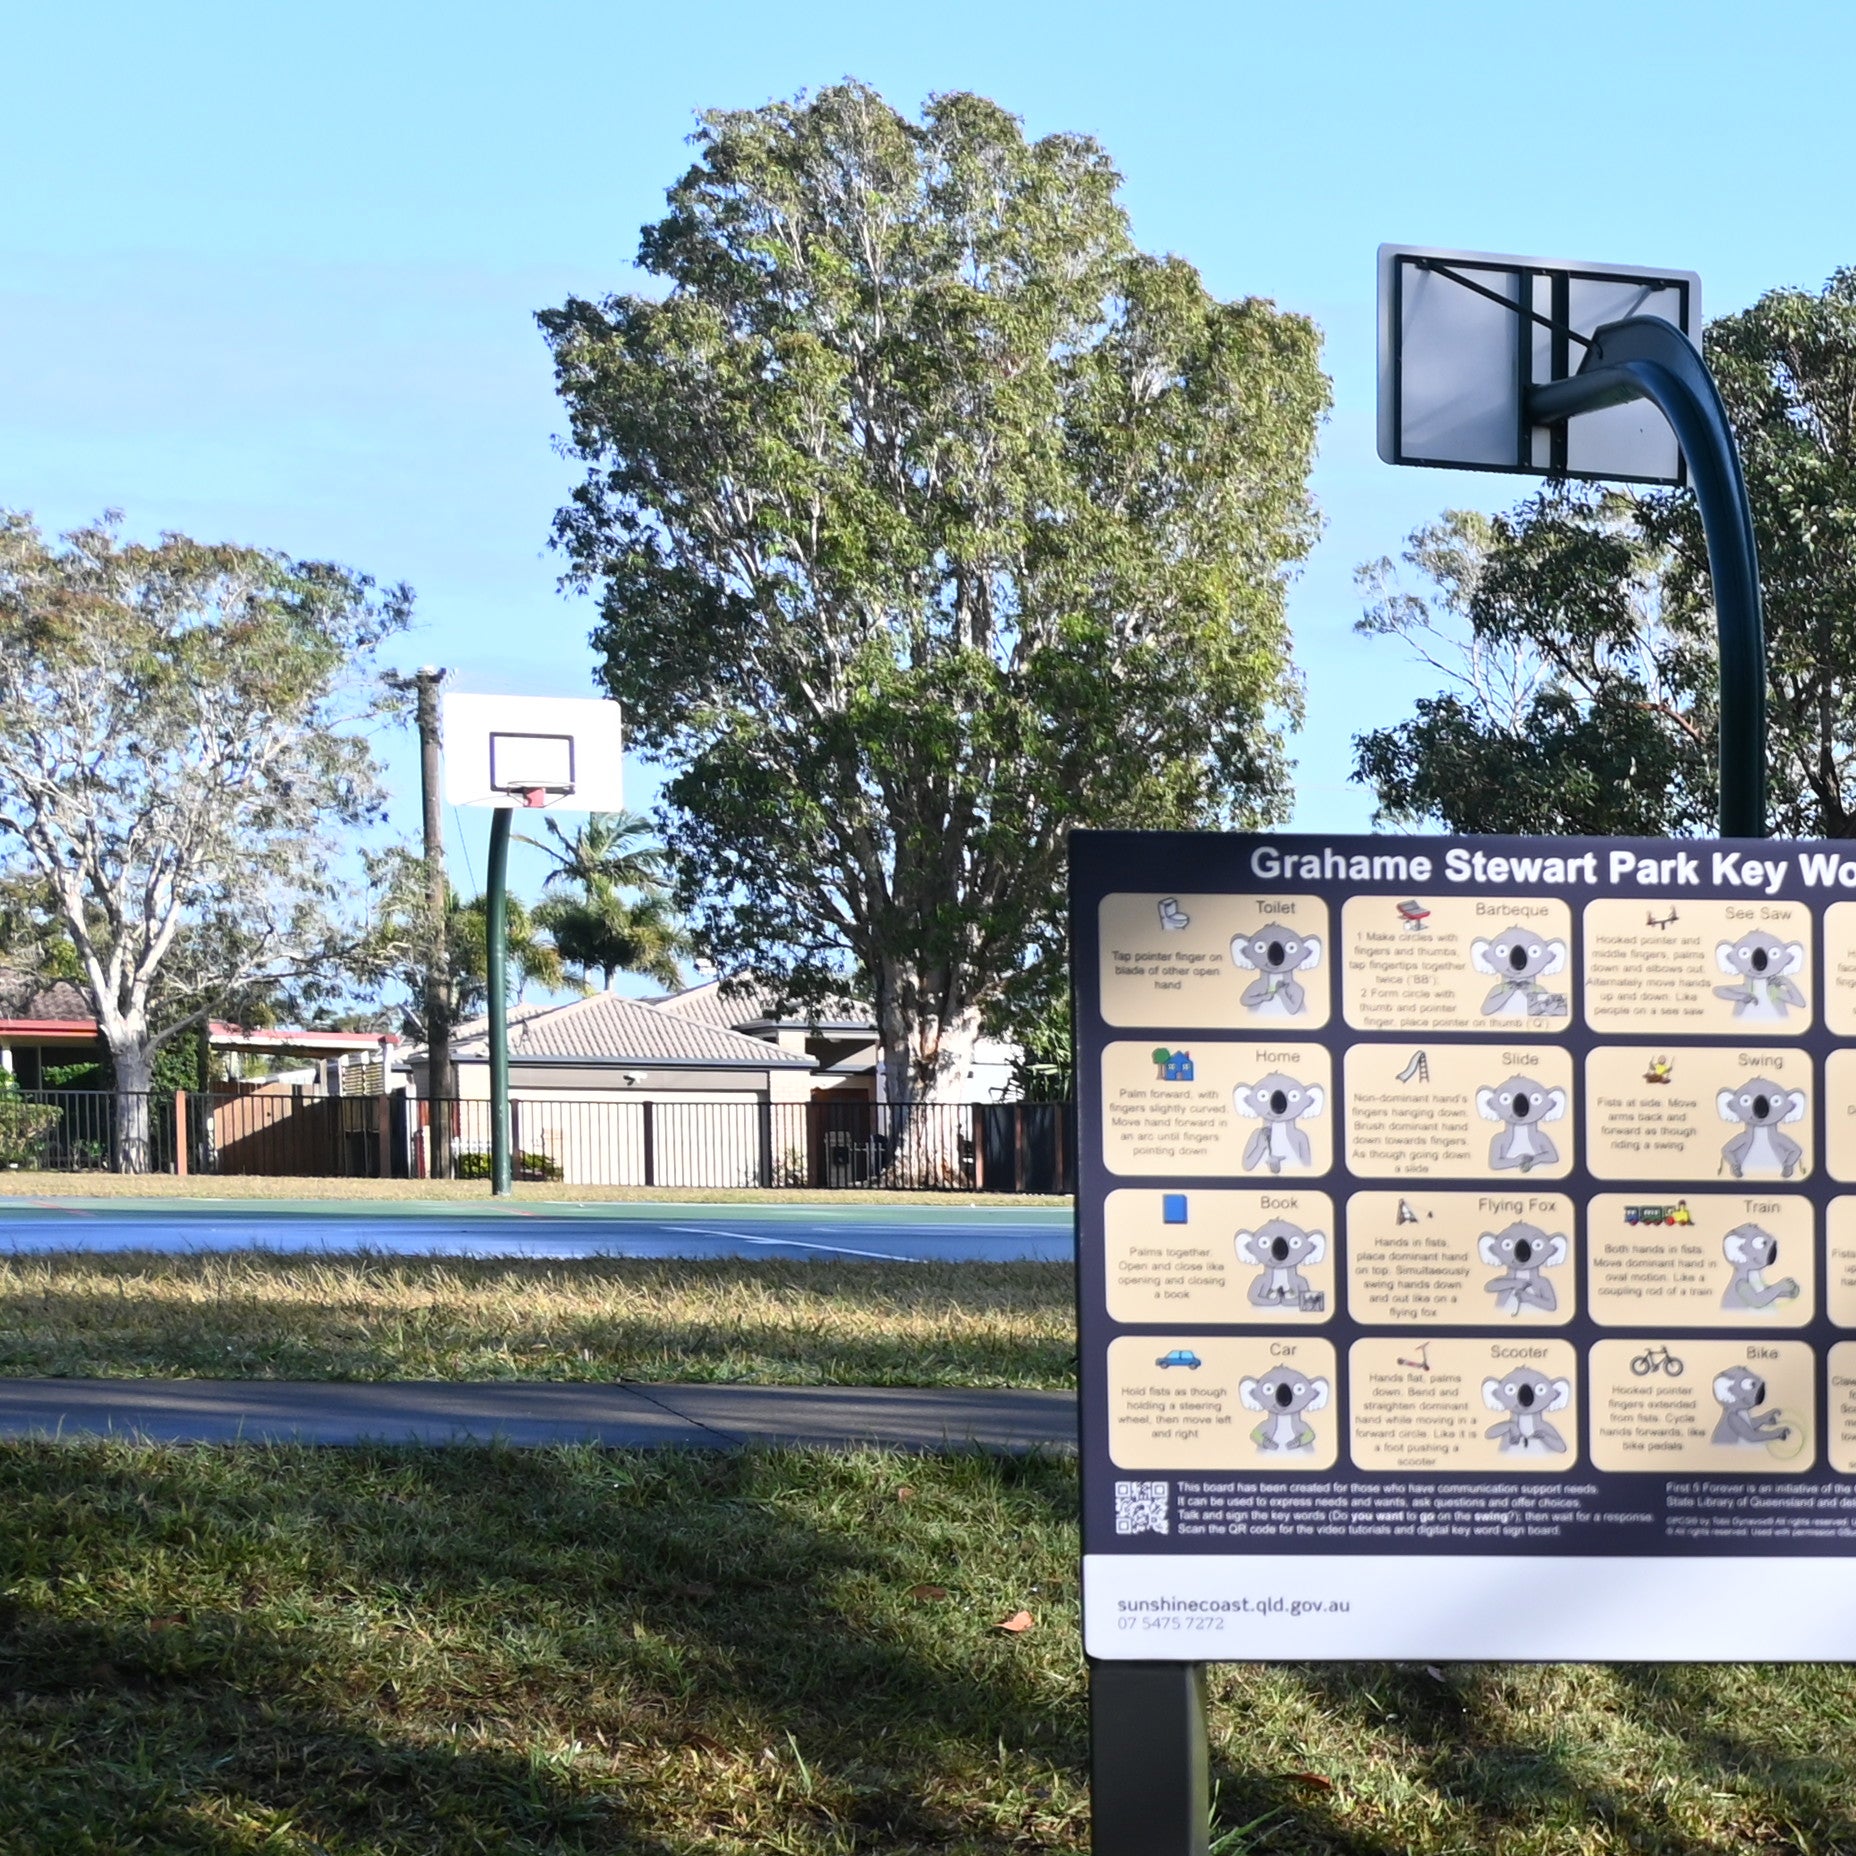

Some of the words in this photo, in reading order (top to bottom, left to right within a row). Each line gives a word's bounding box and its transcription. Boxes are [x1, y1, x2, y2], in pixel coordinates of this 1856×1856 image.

[1251, 846, 1433, 882] Grahame
[1445, 848, 1598, 884] Stewart
[1609, 850, 1700, 885] Park
[1712, 852, 1788, 895] Key
[1256, 900, 1296, 914] Toilet
[1476, 903, 1548, 917] Barbeque
[1725, 906, 1755, 920] See
[1760, 906, 1792, 920] Saw
[1256, 1049, 1301, 1063] Home
[1502, 1052, 1539, 1066] Slide
[1739, 1053, 1783, 1070] Swing
[1260, 1195, 1299, 1209] Book
[1478, 1197, 1524, 1215] Flying
[1529, 1198, 1556, 1212] Fox
[1743, 1199, 1781, 1214] Train
[1270, 1342, 1297, 1356] Car
[1491, 1344, 1548, 1359] Scooter
[1746, 1346, 1779, 1360] Bike
[1177, 1481, 1201, 1493] This
[1203, 1482, 1235, 1493] board
[1237, 1482, 1258, 1492] has
[1260, 1483, 1287, 1493] been
[1289, 1483, 1331, 1493] created
[1333, 1482, 1348, 1493] for
[1350, 1483, 1381, 1493] those
[1383, 1483, 1406, 1493] who
[1408, 1484, 1435, 1493] have
[1437, 1484, 1519, 1494] communication
[1521, 1484, 1562, 1495] support
[1564, 1484, 1597, 1494] needs.
[1117, 1596, 1350, 1617] sunshinecoast.qld.gov.au
[1117, 1616, 1137, 1630] 07
[1142, 1616, 1181, 1630] 5475
[1185, 1616, 1224, 1630] 7272
